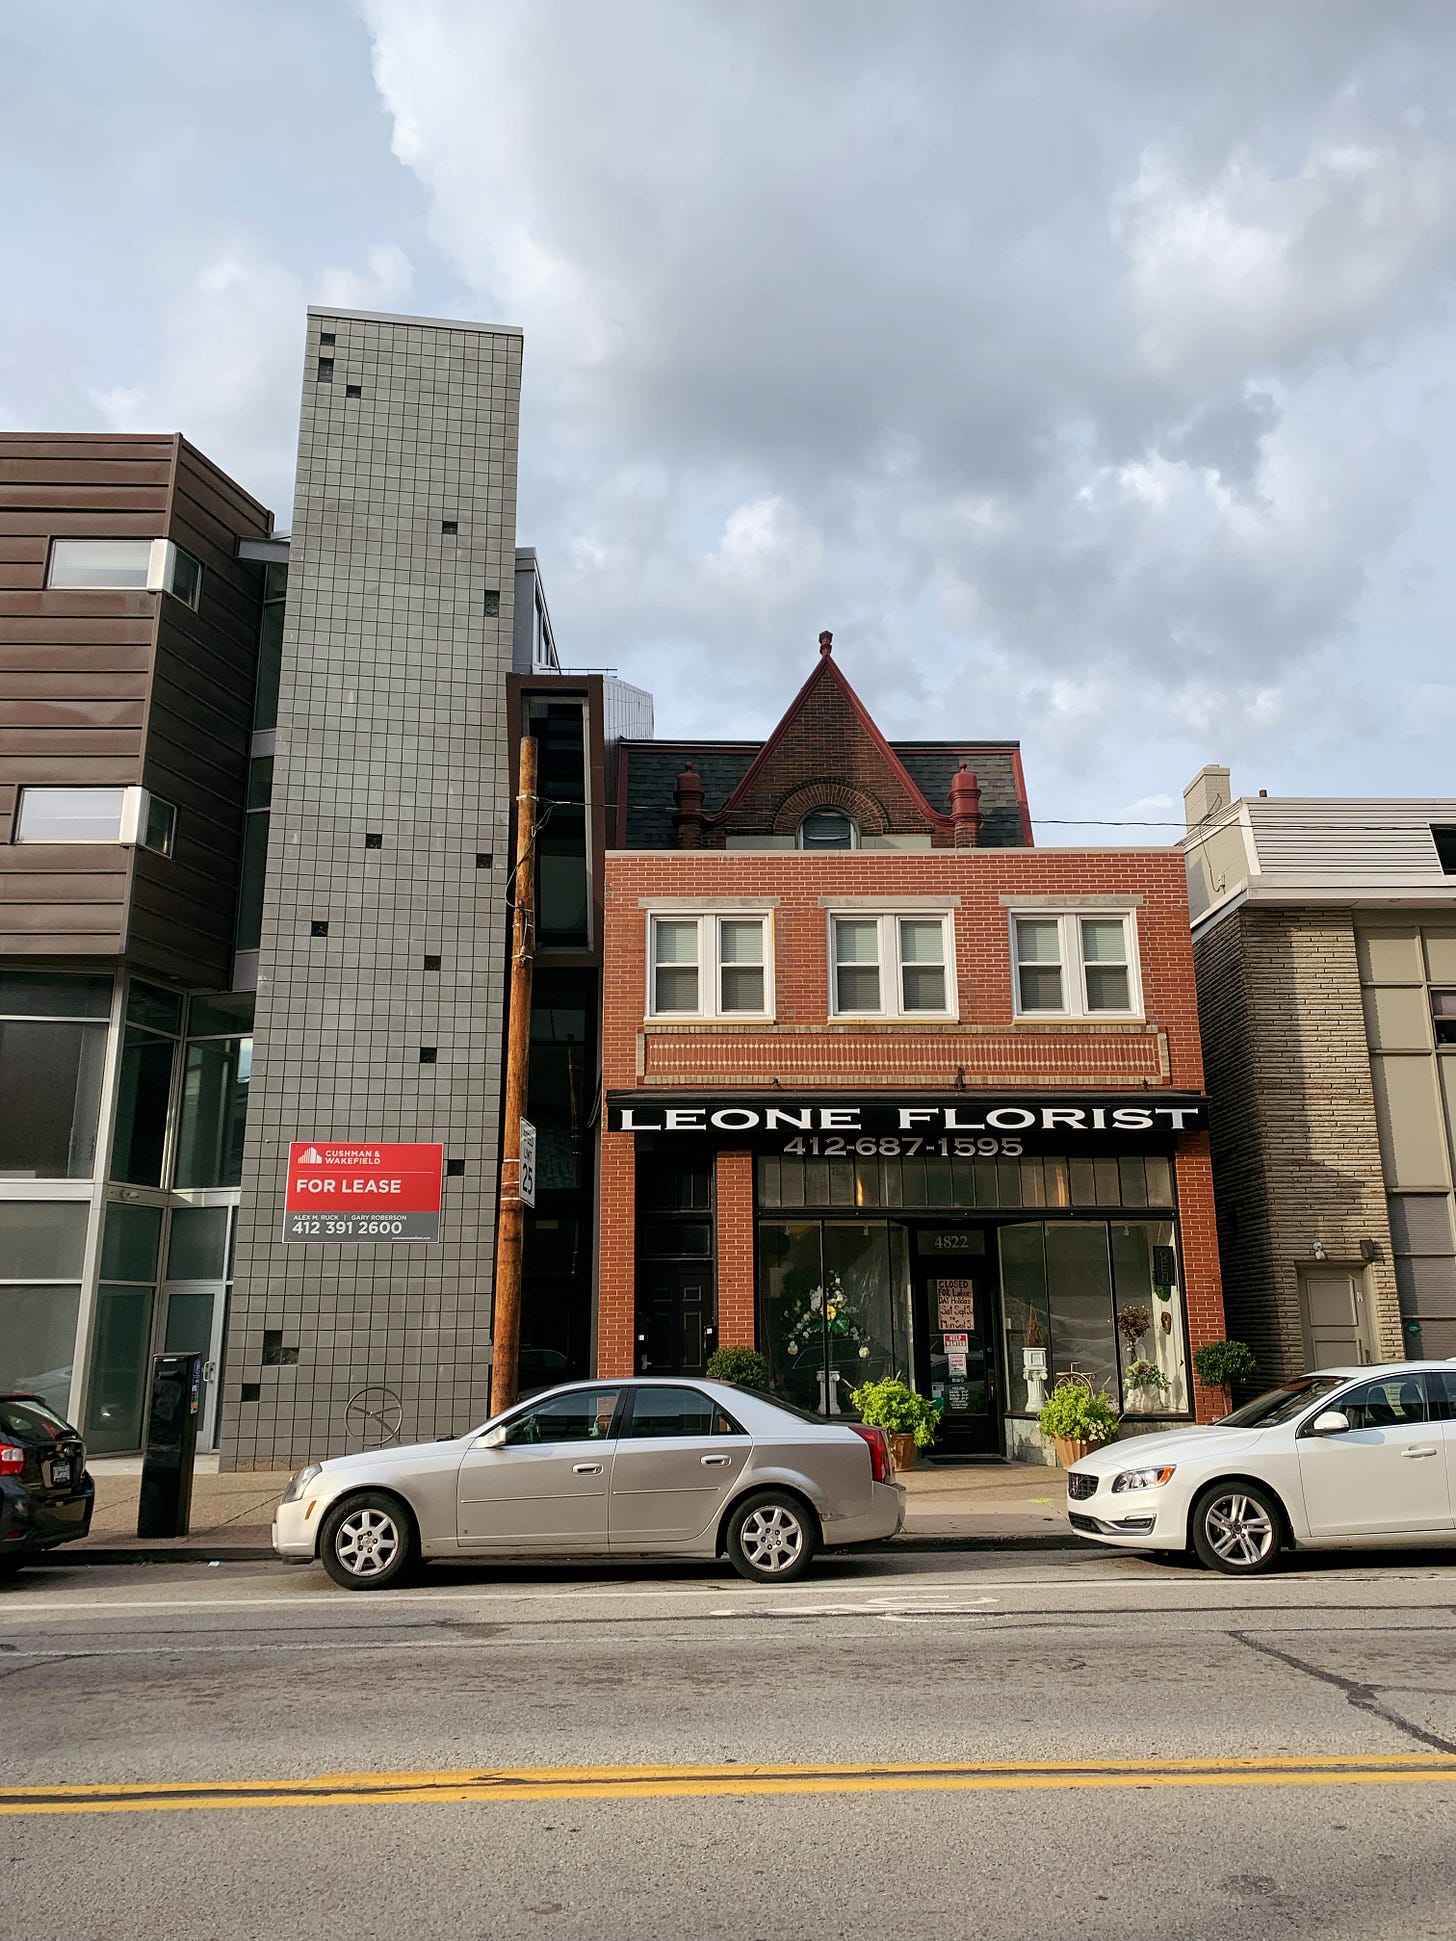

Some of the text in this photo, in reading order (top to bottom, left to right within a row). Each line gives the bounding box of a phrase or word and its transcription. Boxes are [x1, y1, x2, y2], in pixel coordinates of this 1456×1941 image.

[620, 1107, 1199, 1131] LEONE FLORIST
[784, 1136, 1023, 1156] 412-687-1595
[296, 1179, 402, 1194] FOR LEASE
[522, 1163, 532, 1195] 25
[292, 1222, 402, 1234] 412 391 2600
[934, 1236, 968, 1248] 4822
[938, 1280, 968, 1288] CLOSED
